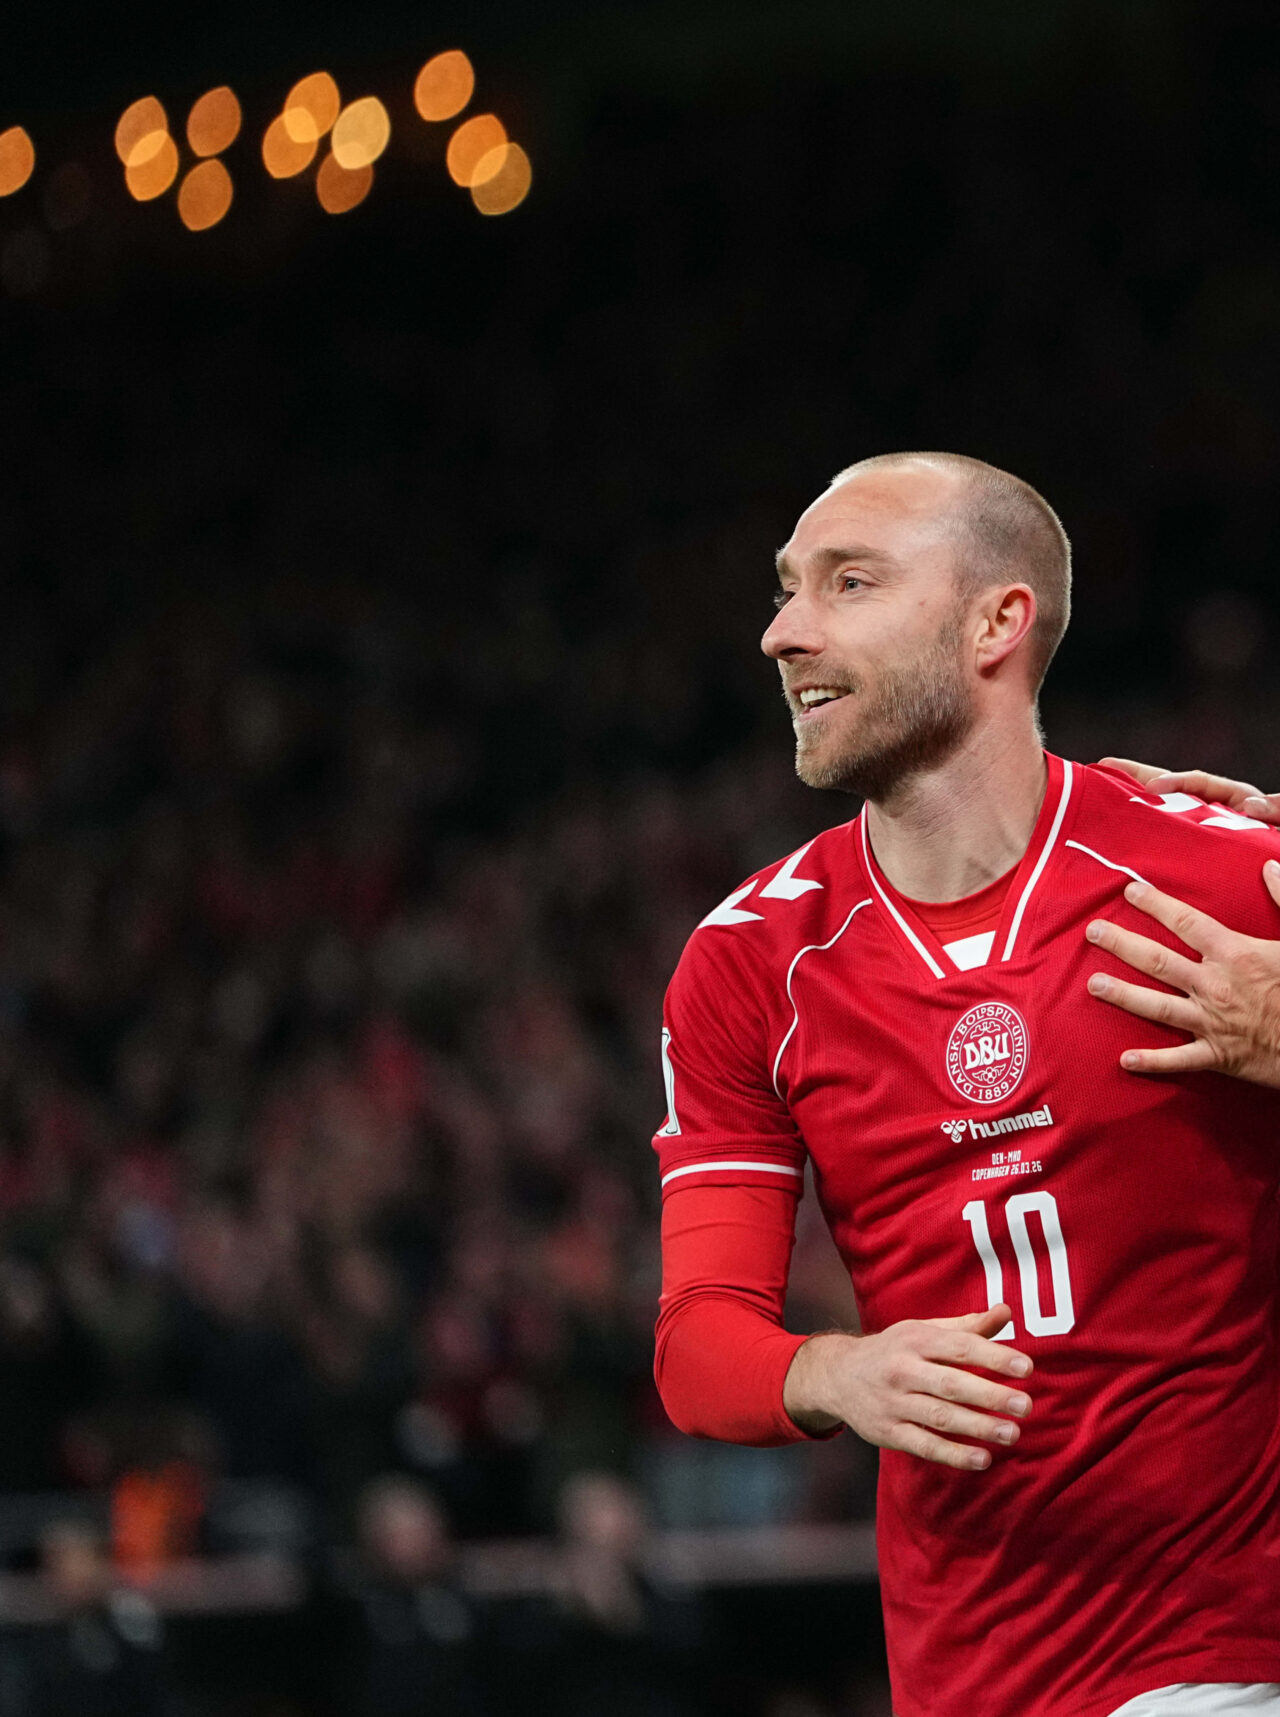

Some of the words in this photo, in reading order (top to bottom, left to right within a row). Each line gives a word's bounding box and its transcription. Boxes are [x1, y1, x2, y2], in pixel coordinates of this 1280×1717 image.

[950, 1040, 974, 1095] DANSK
[1010, 1025, 1024, 1079] UNION
[963, 1032, 1011, 1070] DBU
[978, 1081, 1010, 1100] 1889
[967, 1104, 1054, 1140] hummel
[971, 1165, 1010, 1181] COPENHAGEN
[1010, 1160, 1043, 1175] 26.03.26
[962, 1190, 1076, 1342] 10
